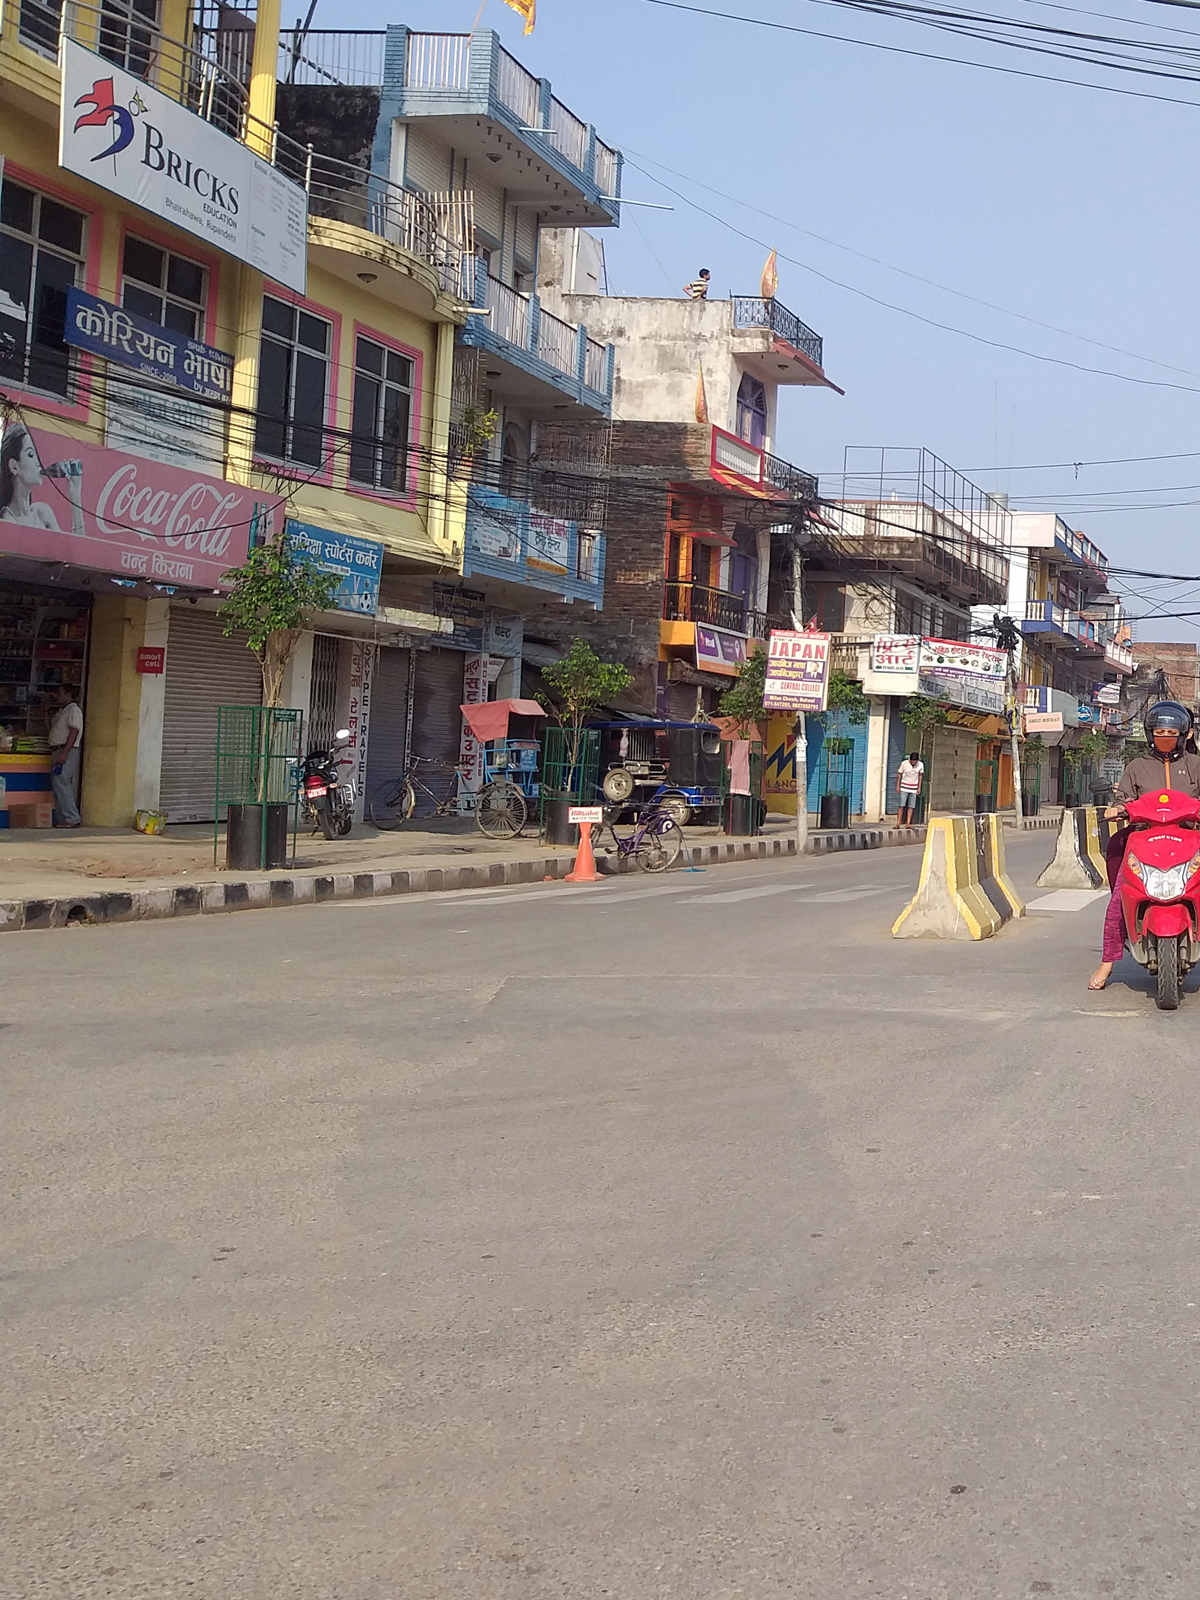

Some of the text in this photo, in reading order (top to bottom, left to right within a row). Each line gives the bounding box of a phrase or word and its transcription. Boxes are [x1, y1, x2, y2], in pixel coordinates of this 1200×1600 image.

[140, 120, 239, 215] BRICKS
[166, 197, 237, 243] Bhairahawa, Rupandehi
[203, 203, 238, 230] EDUCATION
[75, 303, 231, 392] कोरियन भाषा
[96, 464, 244, 557] Coca-Cola
[121, 551, 194, 580] चन्द्र किराना
[355, 549, 379, 569] कर्नर
[770, 641, 826, 660] JAPAN
[875, 650, 916, 665] आर्ट
[362, 644, 372, 707] SKYPE
[780, 681, 821, 692] CENTRAL COLLEGE
[357, 712, 368, 797] TRAVELS
